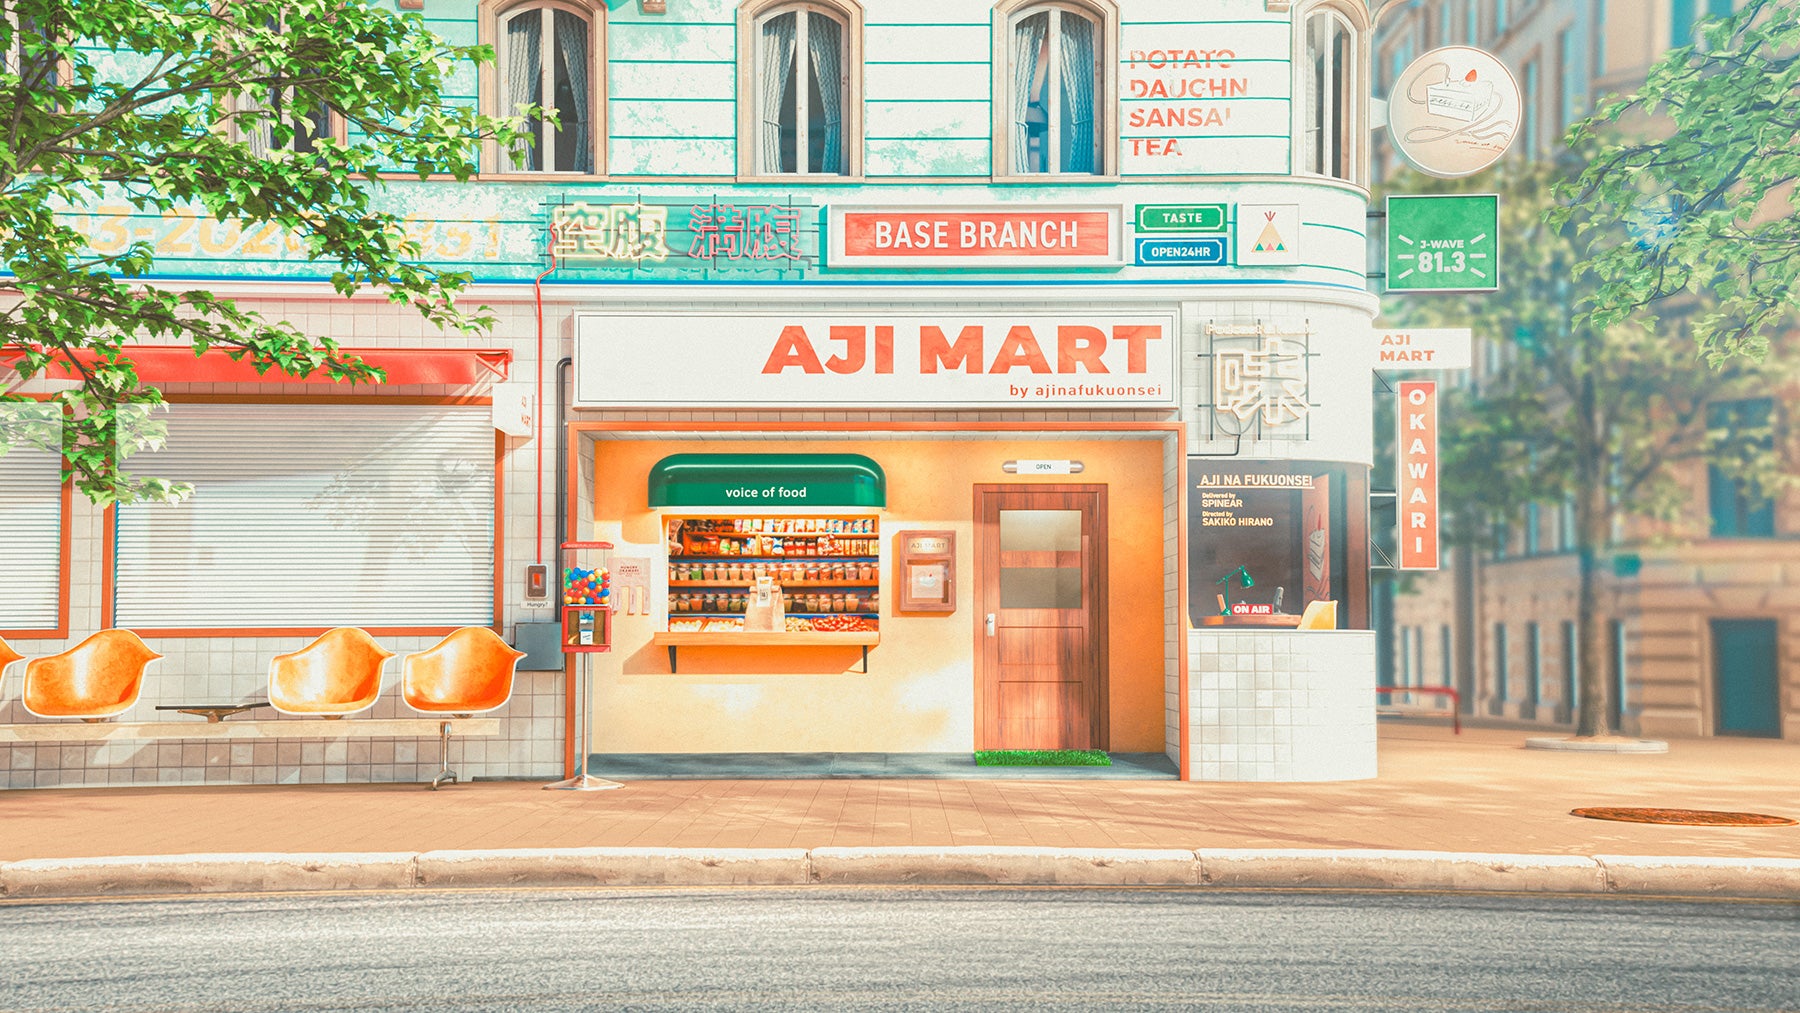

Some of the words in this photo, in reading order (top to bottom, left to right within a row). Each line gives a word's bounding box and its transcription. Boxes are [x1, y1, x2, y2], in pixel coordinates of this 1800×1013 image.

[1128, 138, 1183, 156] TEA
[1162, 212, 1203, 223] TASTE
[553, 202, 669, 259] 空腹
[689, 204, 802, 260] 満腹
[875, 221, 949, 248] BASE
[960, 221, 1078, 248] BRANCH
[1420, 240, 1464, 248] J-WAVE
[1151, 247, 1211, 257] OPEN24HR
[1418, 251, 1466, 273] 81.3
[1381, 335, 1411, 345] AJI
[761, 325, 894, 374] AJI
[920, 325, 1162, 374] MART
[1380, 350, 1435, 361] MART
[1010, 385, 1028, 397] by
[1035, 384, 1162, 398] ajinafukuonsei
[1408, 389, 1428, 553] OKAWARI
[1200, 475, 1220, 485] AJI
[1224, 475, 1241, 485] NA
[1245, 475, 1312, 486] FUKUONSEI
[726, 487, 758, 498] voice
[762, 487, 775, 498] of
[779, 487, 807, 498] food
[1202, 500, 1243, 508] SPINEAR
[1202, 518, 1236, 526] SAKIKO
[1238, 518, 1273, 526] HIRANO
[1234, 605, 1249, 614] ON
[1251, 605, 1270, 614] AIR
